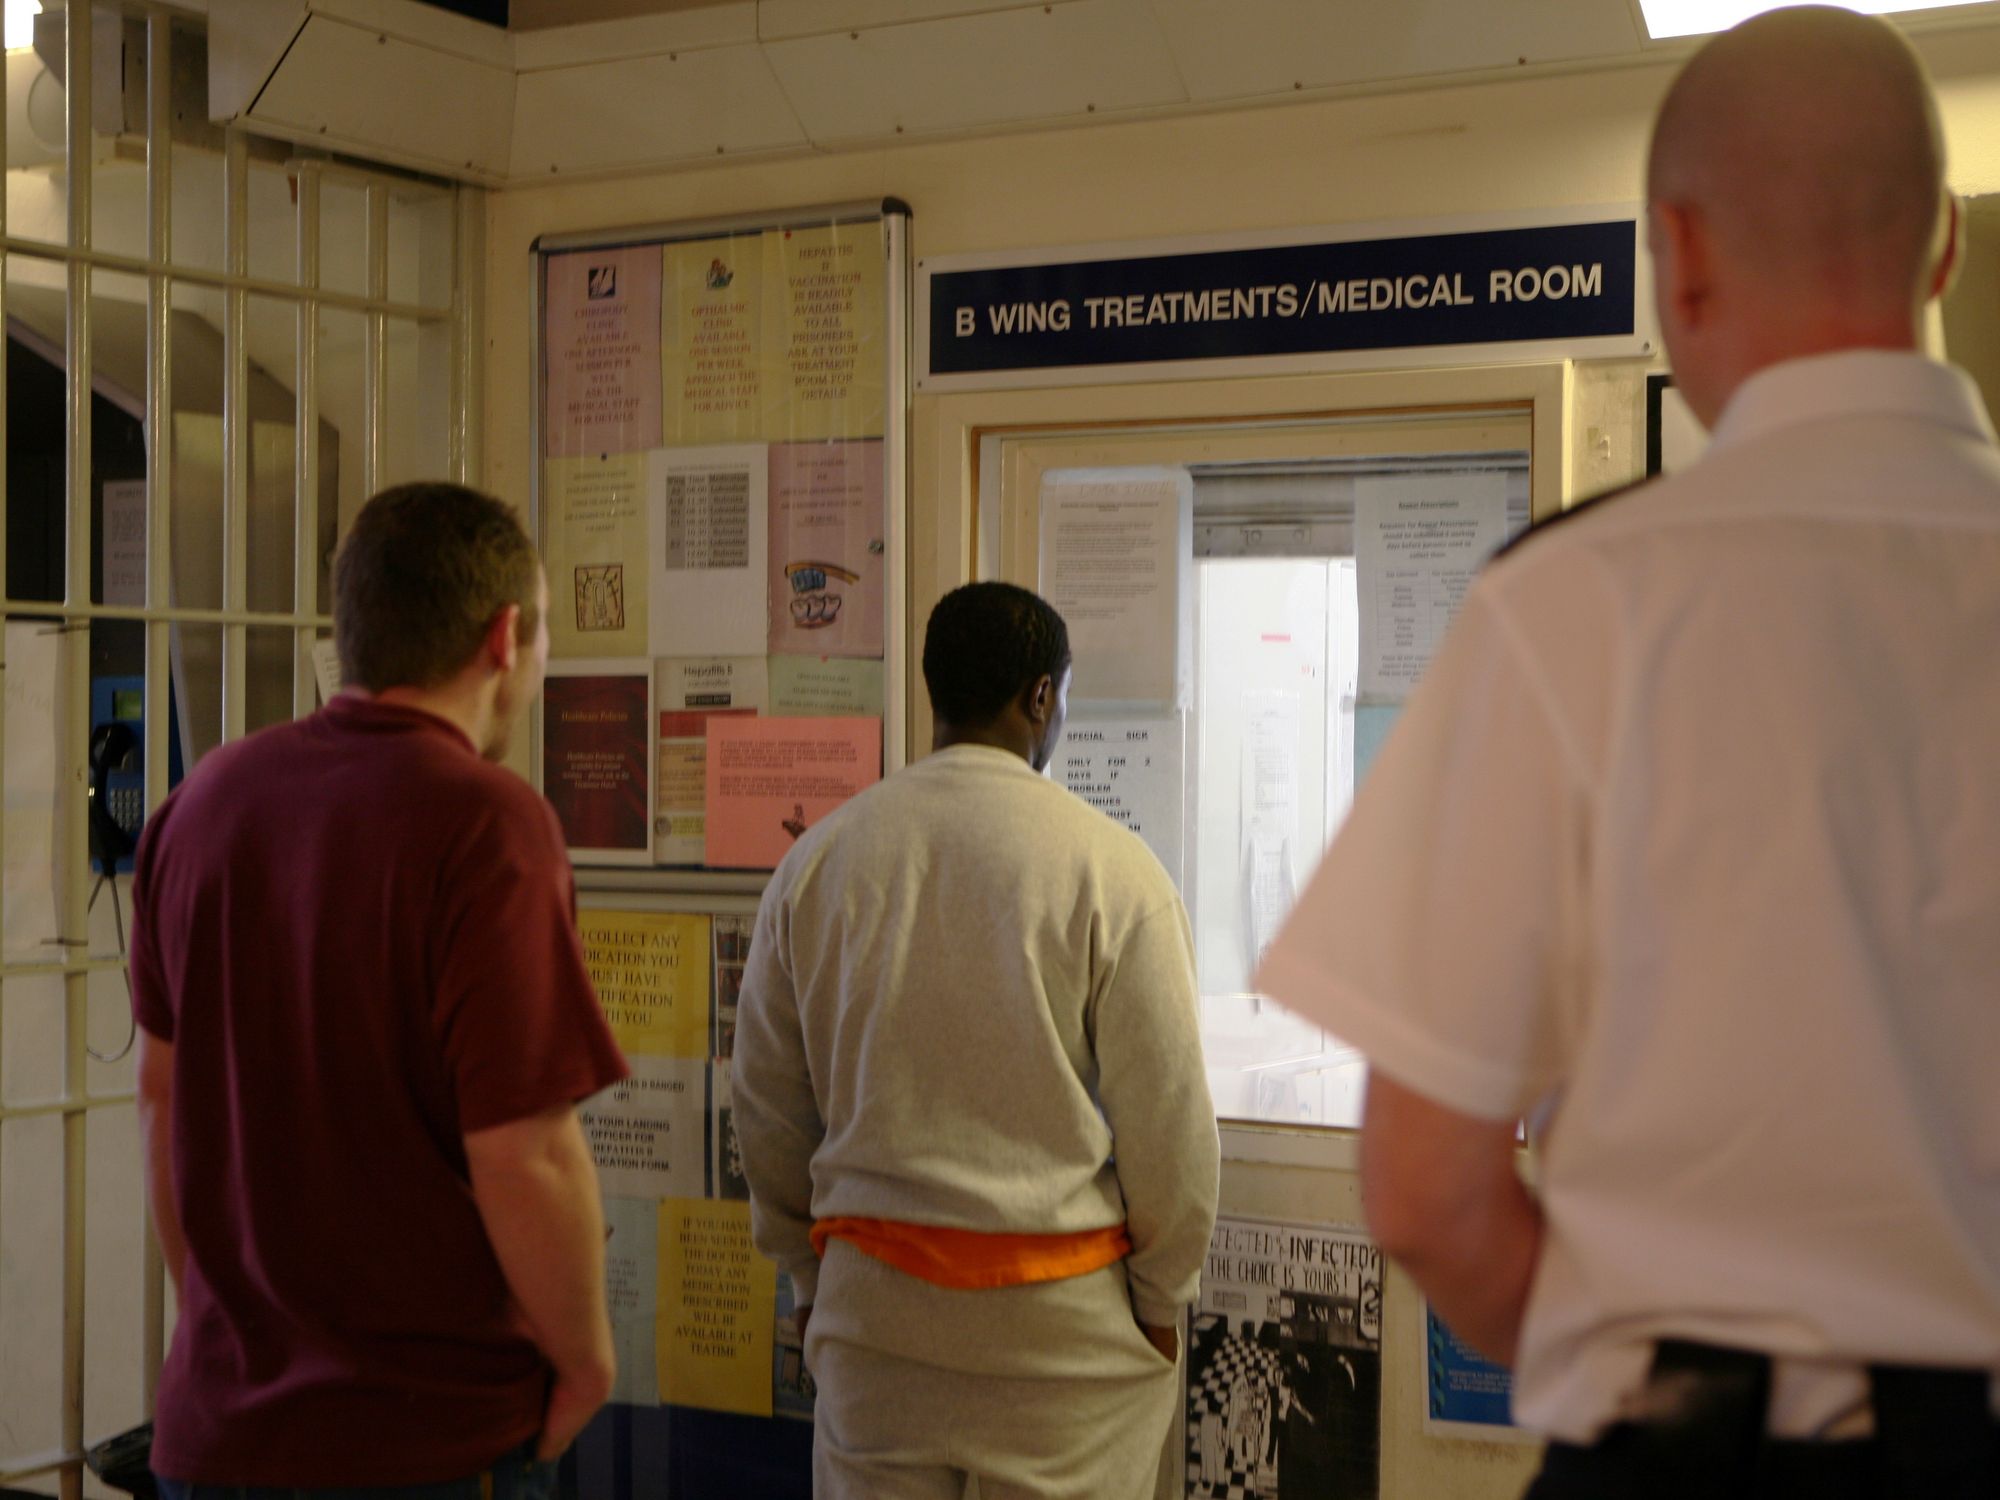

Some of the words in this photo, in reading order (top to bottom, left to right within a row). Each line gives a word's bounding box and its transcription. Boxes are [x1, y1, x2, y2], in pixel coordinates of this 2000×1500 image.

[789, 272, 861, 288] VACCINATION
[955, 306, 975, 337] B
[988, 299, 1071, 334] WING
[1082, 273, 1473, 328] TREATMENTS/MEDICAL
[1489, 263, 1603, 303] ROOM
[794, 303, 853, 316] AVAILABLE
[1067, 731, 1104, 741] SPECIAL
[1126, 730, 1149, 740] SICK
[1067, 757, 1092, 767] ONLY
[1108, 757, 1126, 767] FOR
[1067, 771, 1091, 780] DAYS
[1110, 770, 1119, 780] IF
[588, 928, 648, 946] COLLECT
[650, 934, 680, 950] ANY
[583, 948, 646, 966] DICATION
[649, 953, 680, 969] YOU
[624, 971, 660, 988] HAVE
[624, 1009, 652, 1026] YOU
[599, 1114, 624, 1128] YOUR
[591, 1130, 633, 1143] OFFICER
[635, 1131, 655, 1144] FOR
[593, 1143, 644, 1156] HEPATITIS
[683, 1215, 691, 1229] IF
[684, 1247, 703, 1260] THE
[1289, 1235, 1378, 1271] INFECTED?
[686, 1263, 721, 1277] TODAY
[726, 1266, 748, 1280] ANY
[1209, 1255, 1231, 1281] THE
[1238, 1258, 1276, 1286] CHOICE
[1284, 1261, 1294, 1289] IS
[681, 1279, 751, 1296] MEDICATION
[682, 1295, 748, 1311] PRESCRIBED
[693, 1311, 719, 1324] WILL
[722, 1312, 736, 1325] BE
[675, 1325, 736, 1341] AVAILABLE
[738, 1331, 752, 1344] AT
[690, 1343, 736, 1358] TEATIME
